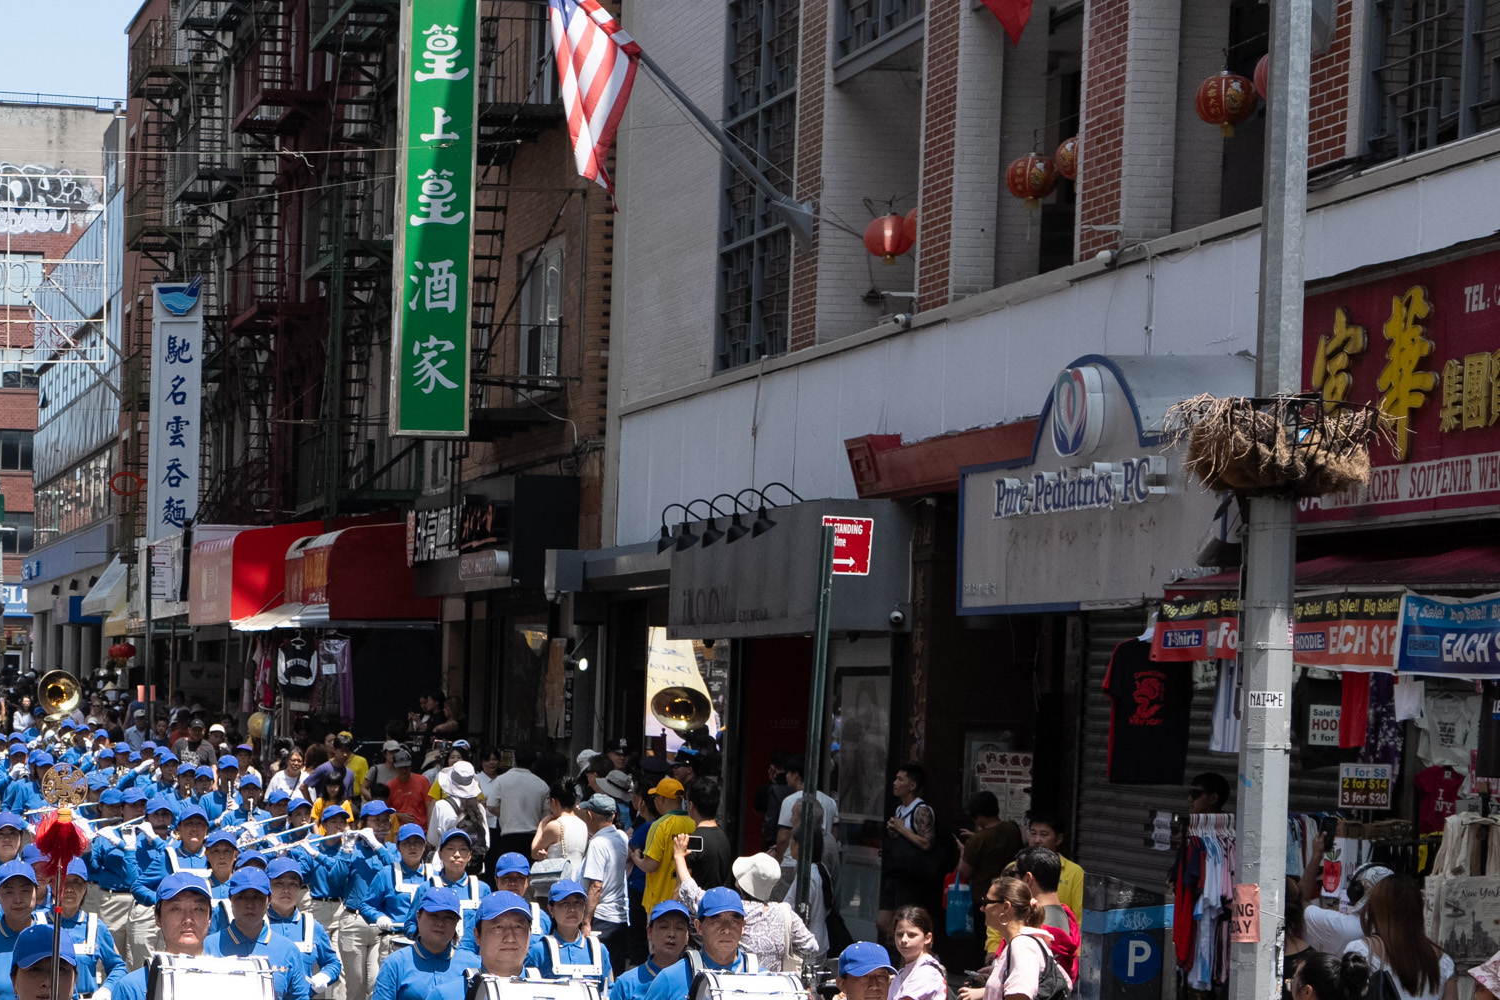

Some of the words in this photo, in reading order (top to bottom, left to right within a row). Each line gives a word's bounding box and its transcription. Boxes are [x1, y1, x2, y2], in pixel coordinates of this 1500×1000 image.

[1464, 284, 1490, 312] TEL:
[1409, 458, 1472, 499] SOUVENIR
[994, 479, 1030, 517] Pure
[1122, 457, 1151, 501] PC
[834, 537, 847, 547] time
[1162, 603, 1178, 618] Big
[1179, 602, 1200, 617] Sale!
[1203, 600, 1218, 614] Big
[1304, 601, 1322, 616] Sale!
[1325, 600, 1338, 617] Big
[1364, 599, 1376, 616] Big
[1419, 604, 1445, 620] Sale!
[1166, 631, 1200, 647] T-Shirt:
[1217, 622, 1238, 650] fo
[1295, 633, 1325, 650] HOODIE:
[1328, 625, 1368, 655] EACH
[1442, 632, 1492, 663] EACH
[1313, 708, 1334, 717] Sale!
[1312, 719, 1340, 730] HOO
[1320, 733, 1336, 742] for
[1355, 768, 1370, 777] for
[1374, 768, 1387, 778] $8
[1343, 779, 1350, 789] 2
[1352, 779, 1367, 789] for
[1369, 778, 1388, 790] $14
[1343, 792, 1350, 803] 3
[1352, 791, 1368, 803] for
[1369, 792, 1388, 805] $20
[1435, 801, 1454, 814] NY
[1127, 940, 1152, 977] P
